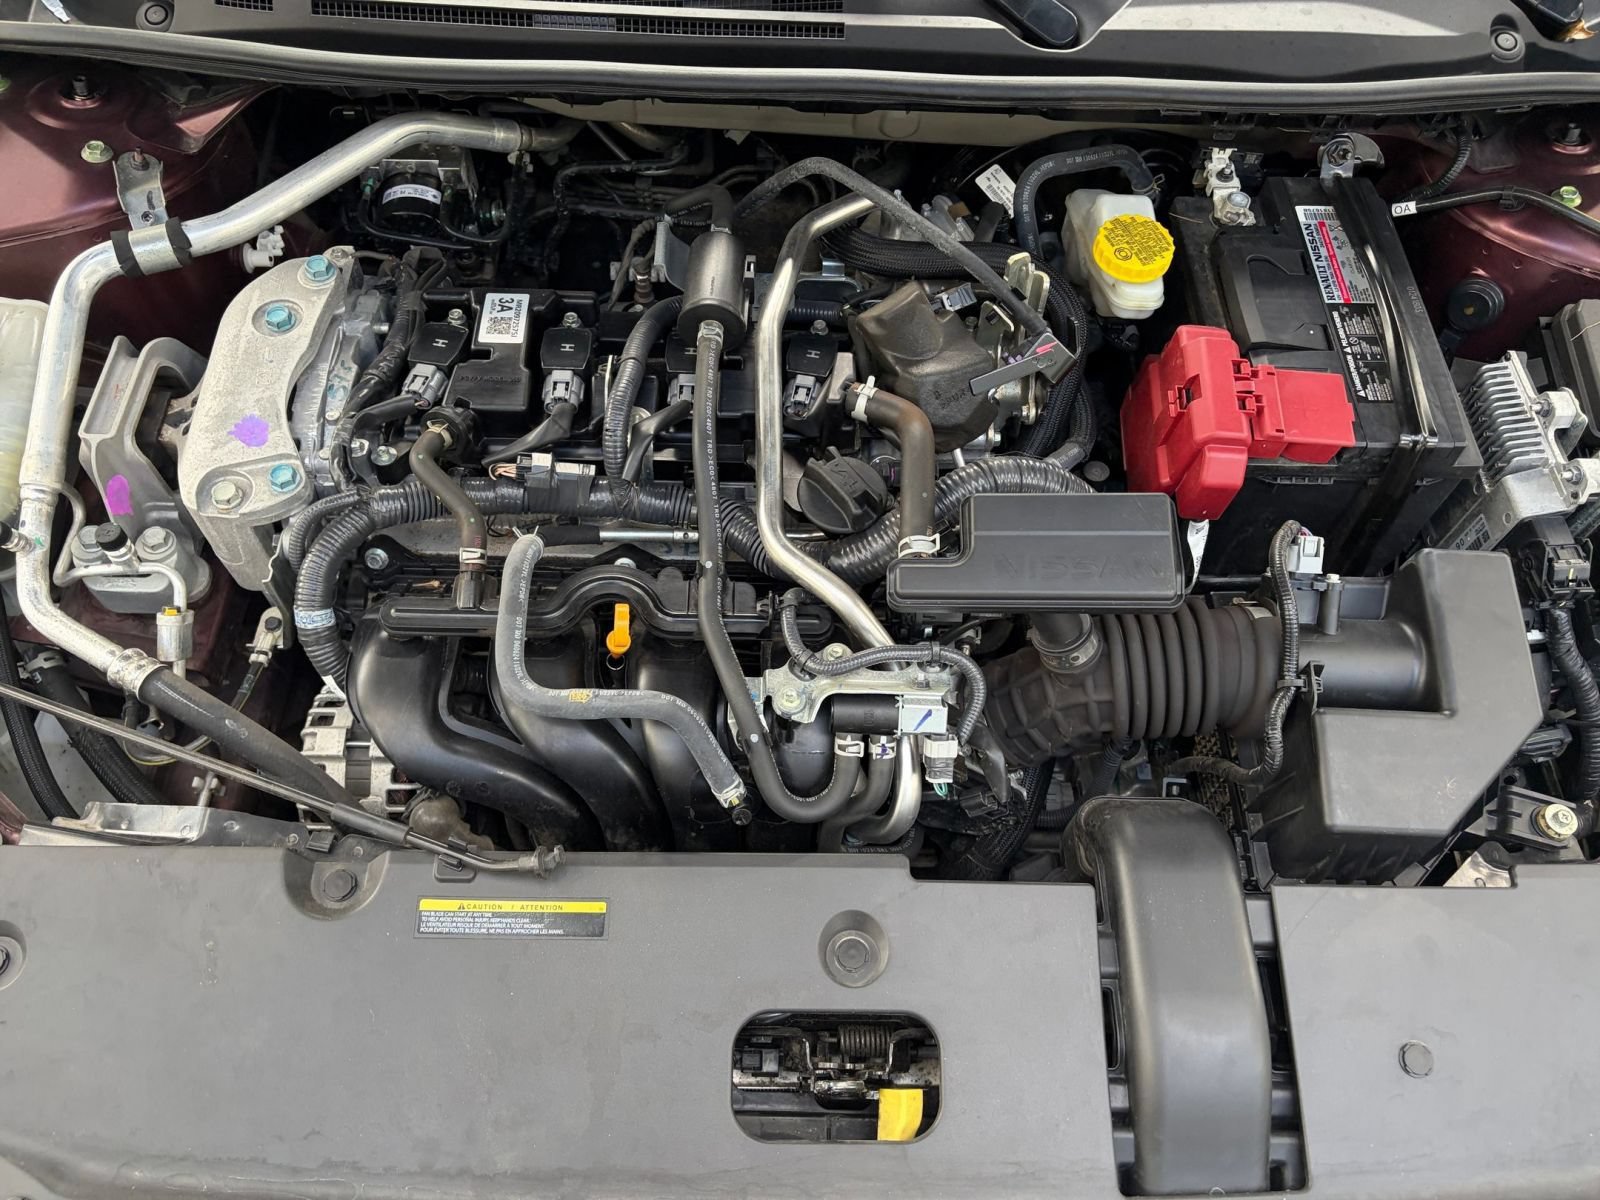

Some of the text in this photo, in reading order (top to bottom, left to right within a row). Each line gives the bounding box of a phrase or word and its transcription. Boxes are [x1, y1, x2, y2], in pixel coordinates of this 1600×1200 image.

[1304, 223, 1322, 262] NISSAN
[1316, 264, 1336, 301] RENAULT
[499, 298, 514, 312] 3A
